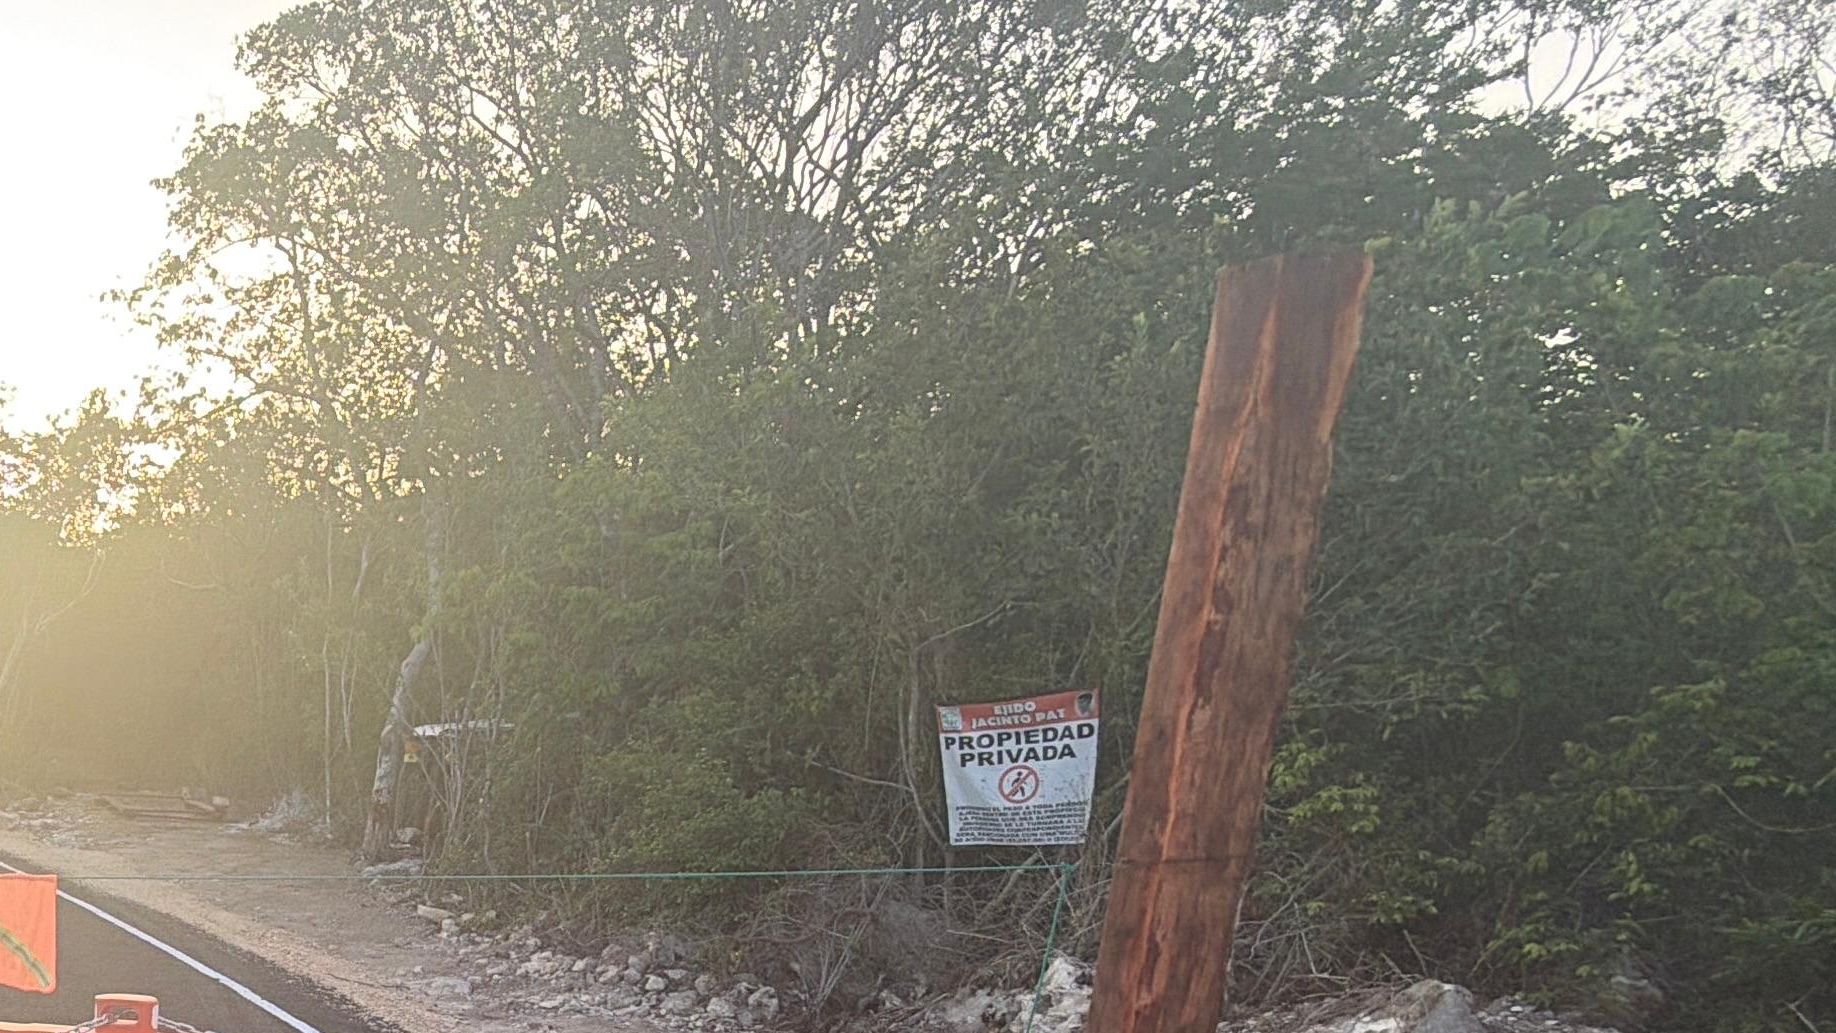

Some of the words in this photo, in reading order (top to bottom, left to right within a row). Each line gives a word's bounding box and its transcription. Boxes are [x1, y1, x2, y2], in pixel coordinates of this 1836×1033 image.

[972, 714, 1031, 729] JACINTO
[1035, 708, 1066, 722] PAT
[994, 701, 1036, 716] EJIDO
[944, 723, 1094, 750] PROPIEDAD
[960, 744, 1076, 767] PRIVADA
